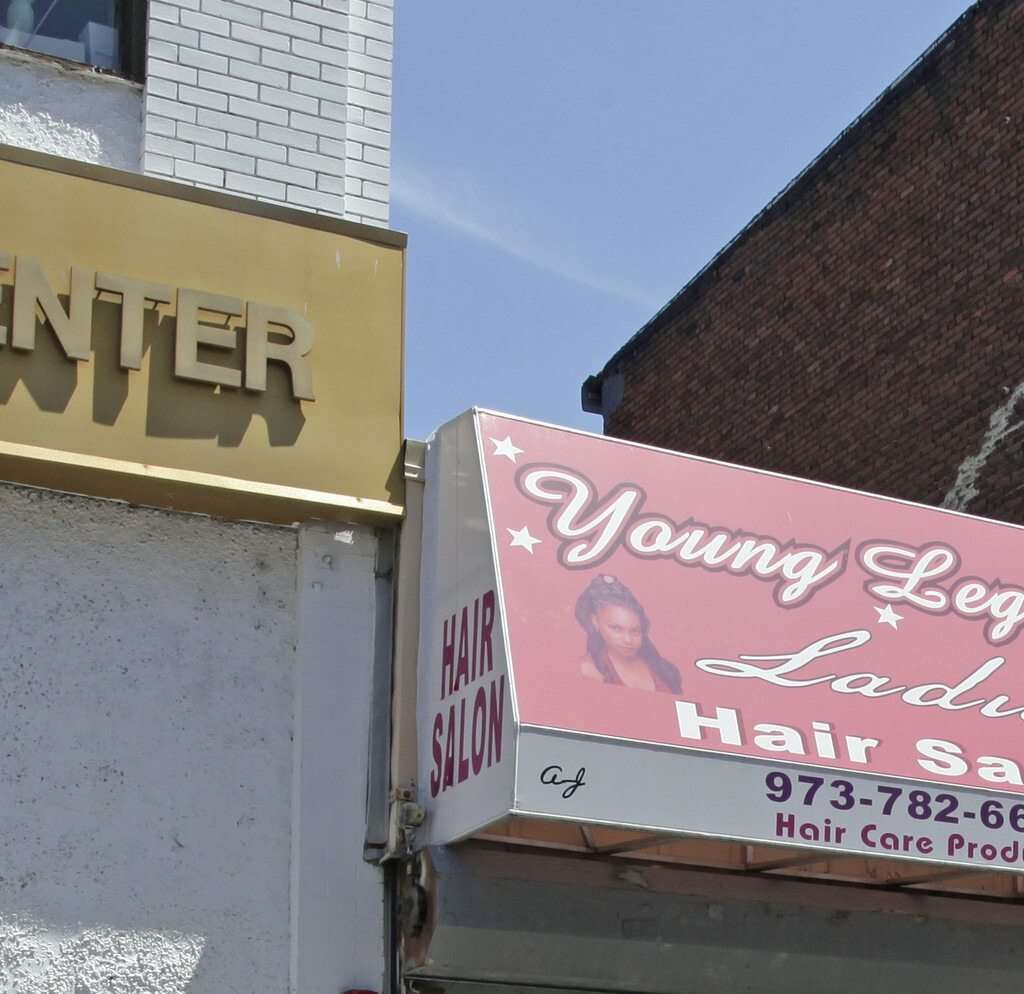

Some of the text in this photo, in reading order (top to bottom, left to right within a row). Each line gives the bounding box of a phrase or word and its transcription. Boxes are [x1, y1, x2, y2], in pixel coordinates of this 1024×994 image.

[516, 462, 850, 607] Young
[439, 590, 496, 700] HAIR
[430, 676, 506, 798] SALON
[674, 700, 880, 764] Hair
[776, 812, 847, 845] Hair
[860, 823, 936, 856] Care
